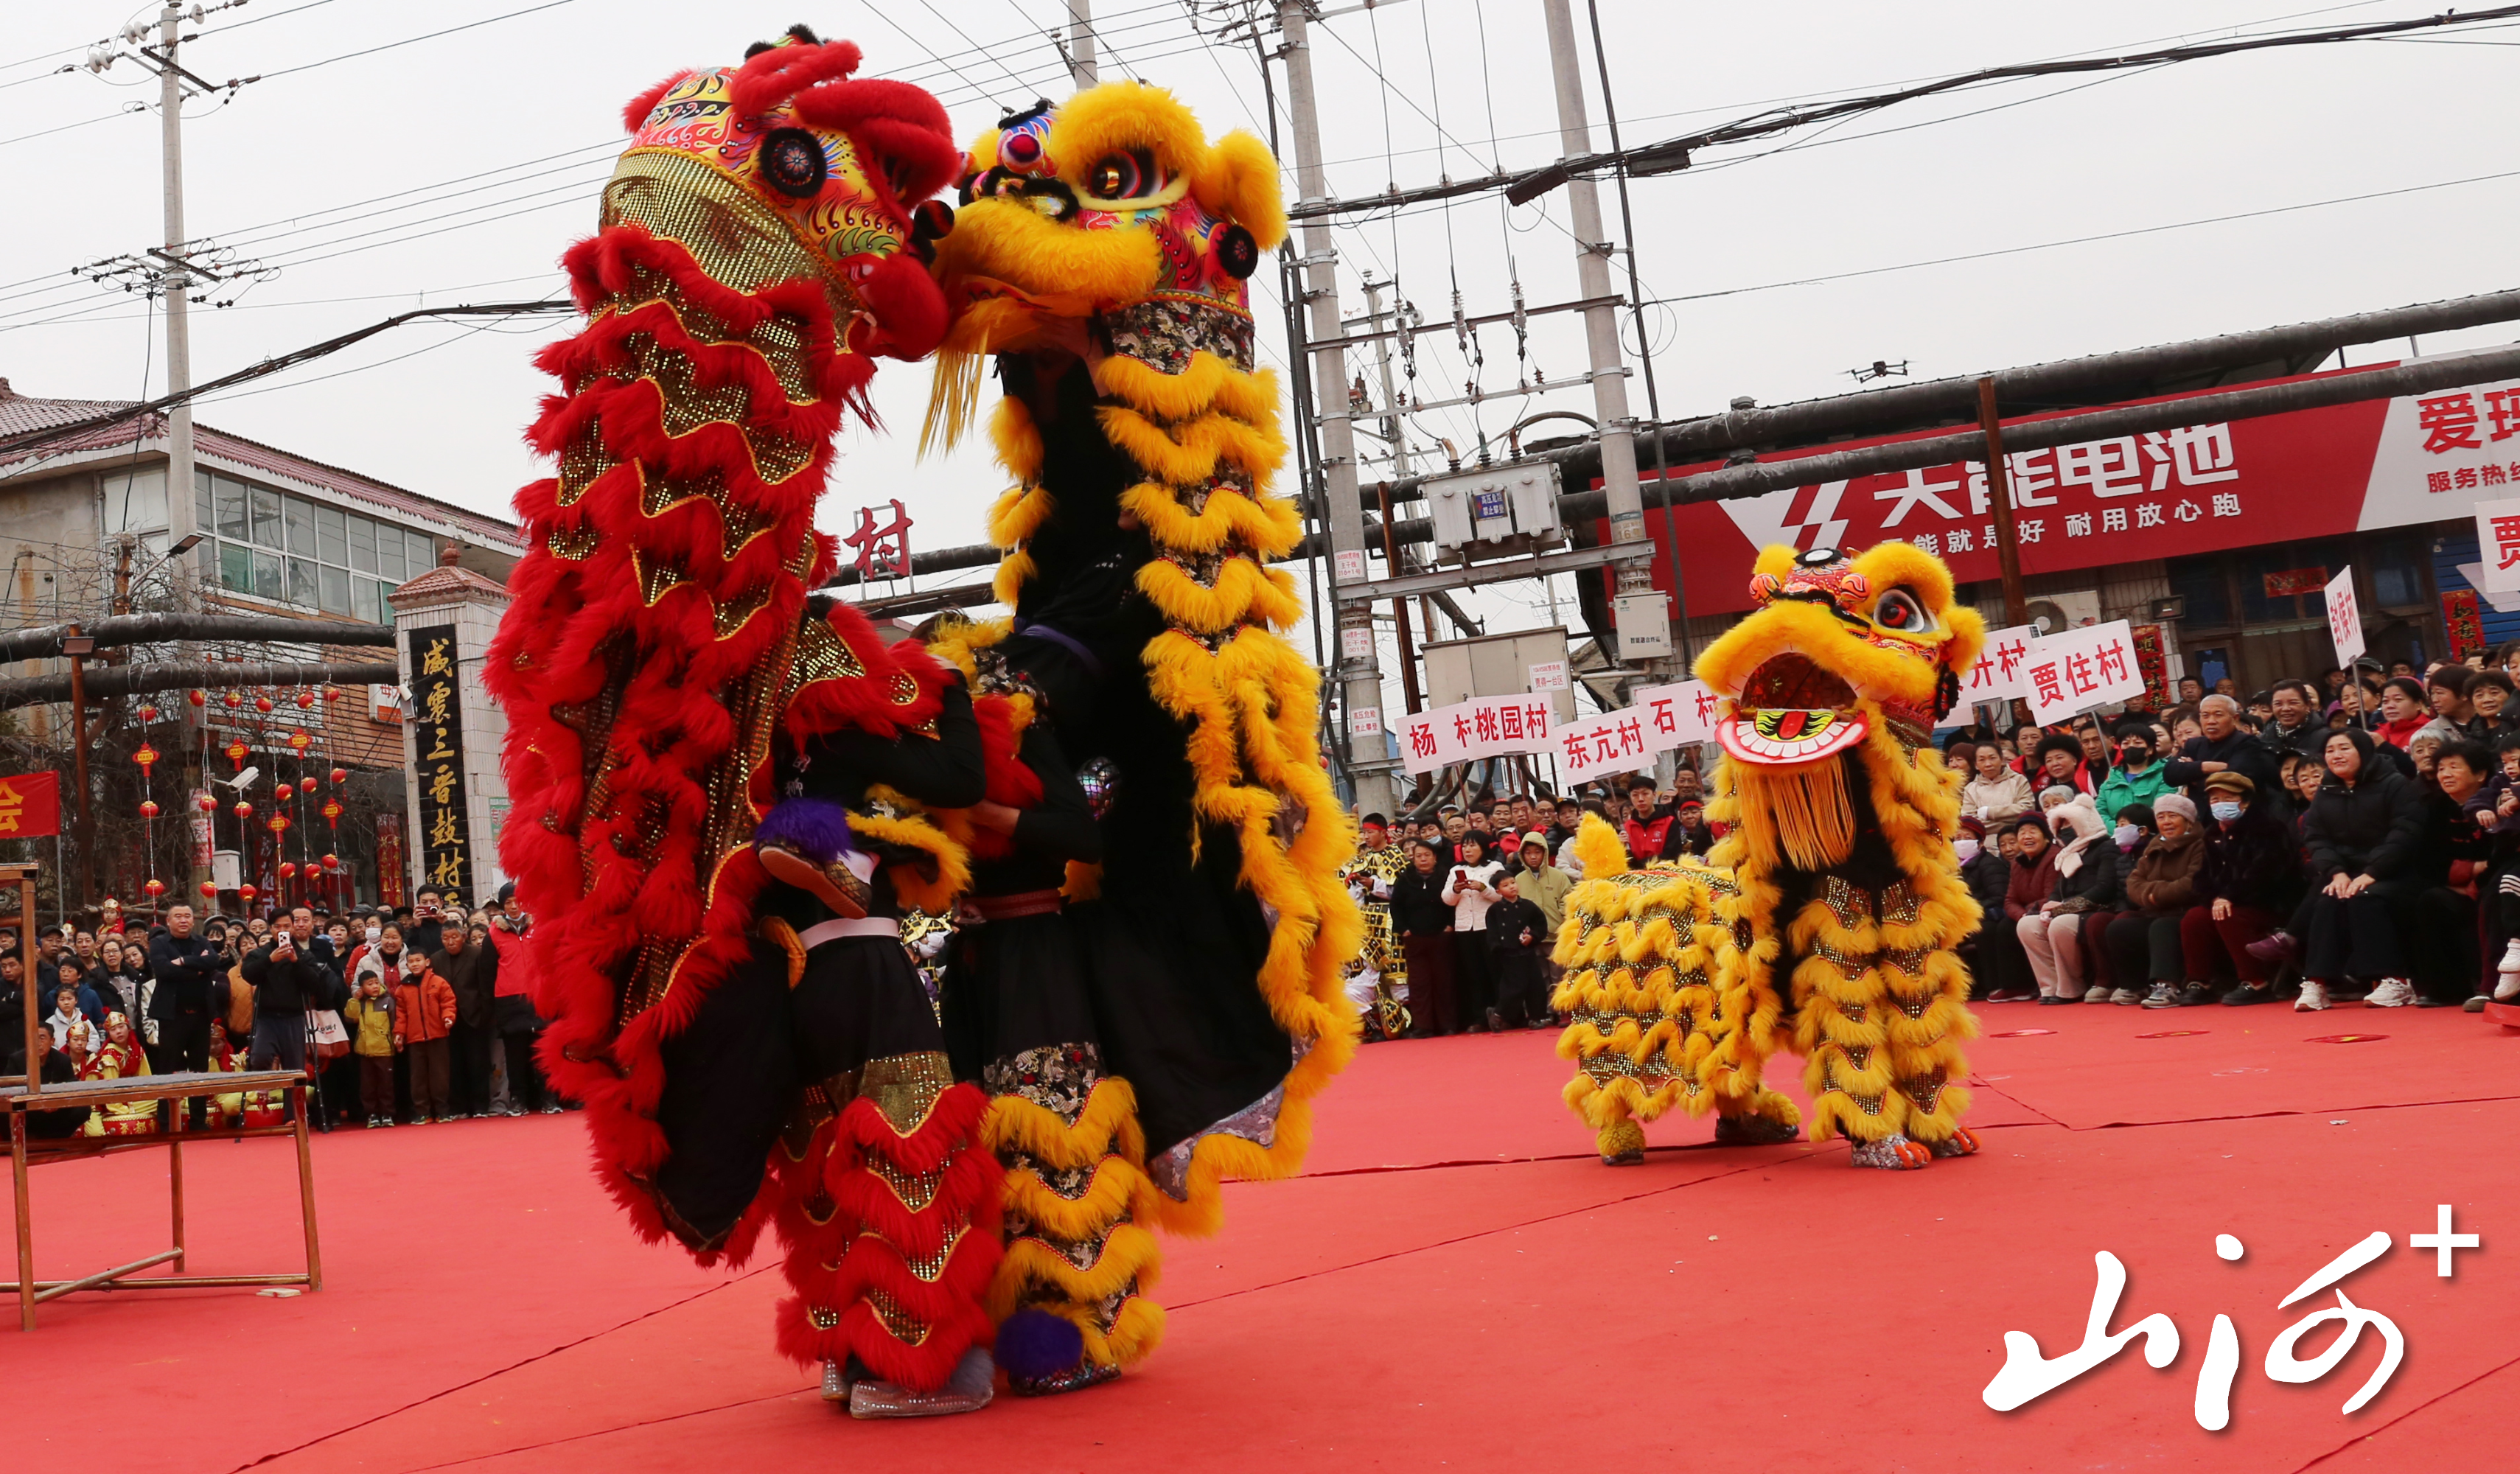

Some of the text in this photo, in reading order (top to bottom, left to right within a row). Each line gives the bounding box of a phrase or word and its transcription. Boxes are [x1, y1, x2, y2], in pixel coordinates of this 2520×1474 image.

[842, 498, 914, 580] 村
[2064, 492, 2241, 538] 耐用放心跑
[2029, 638, 2129, 708] 贾住村
[1474, 702, 1547, 742] 桃园村
[1563, 716, 1644, 769] 东亢村
